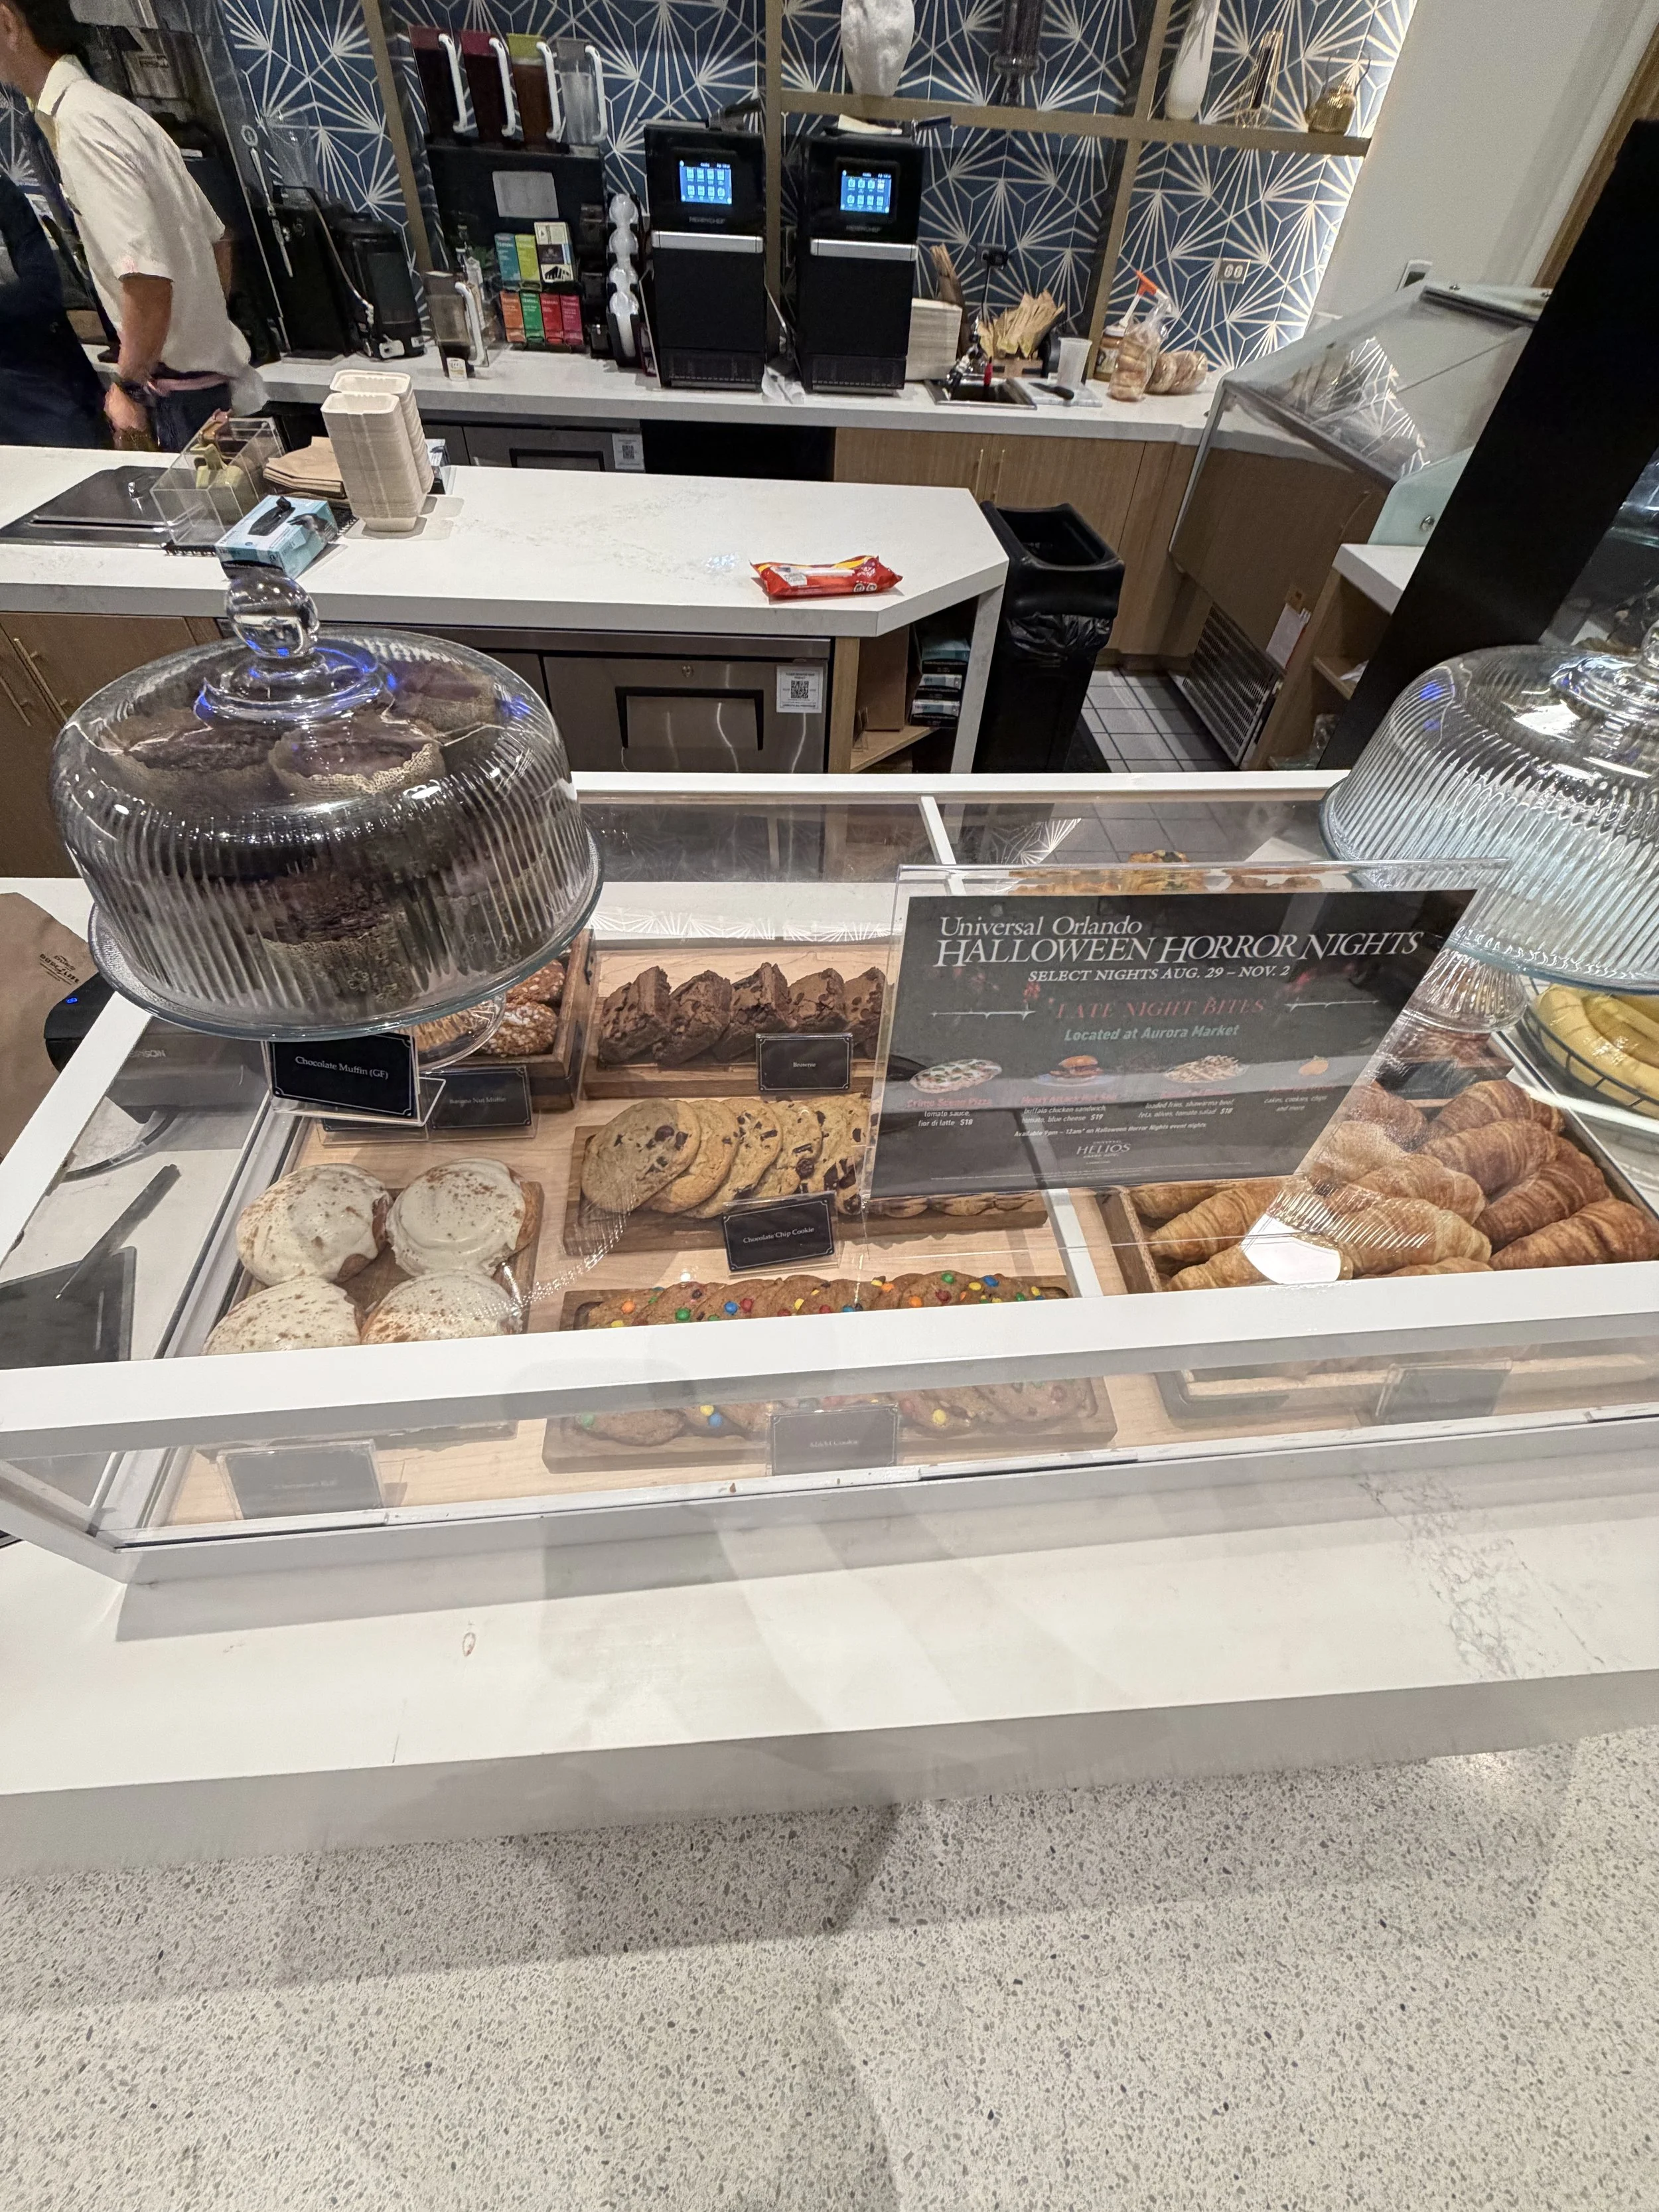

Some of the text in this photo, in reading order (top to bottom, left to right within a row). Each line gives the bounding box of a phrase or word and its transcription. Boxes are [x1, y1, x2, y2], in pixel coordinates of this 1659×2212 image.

[940, 916, 1142, 936] Universal Orlando
[933, 931, 1424, 967] HALLOWEEN HORROR NIGHTS
[1029, 970, 1091, 982] SELECT
[1094, 968, 1157, 981] NIGHTS
[1161, 966, 1200, 980] AUG.
[1204, 966, 1223, 978] 29
[1238, 966, 1276, 978] NOV.
[1279, 966, 1291, 976] 2
[1056, 997, 1264, 1018] LATE NIGHT BITES
[1064, 1024, 1240, 1041] Located at Aurora Market
[295, 1056, 389, 1080] Chocolate Muffin (GF)
[1076, 1143, 1131, 1155] HELIOS
[743, 1234, 774, 1243] Chocolate
[792, 1226, 815, 1236] Cookie
